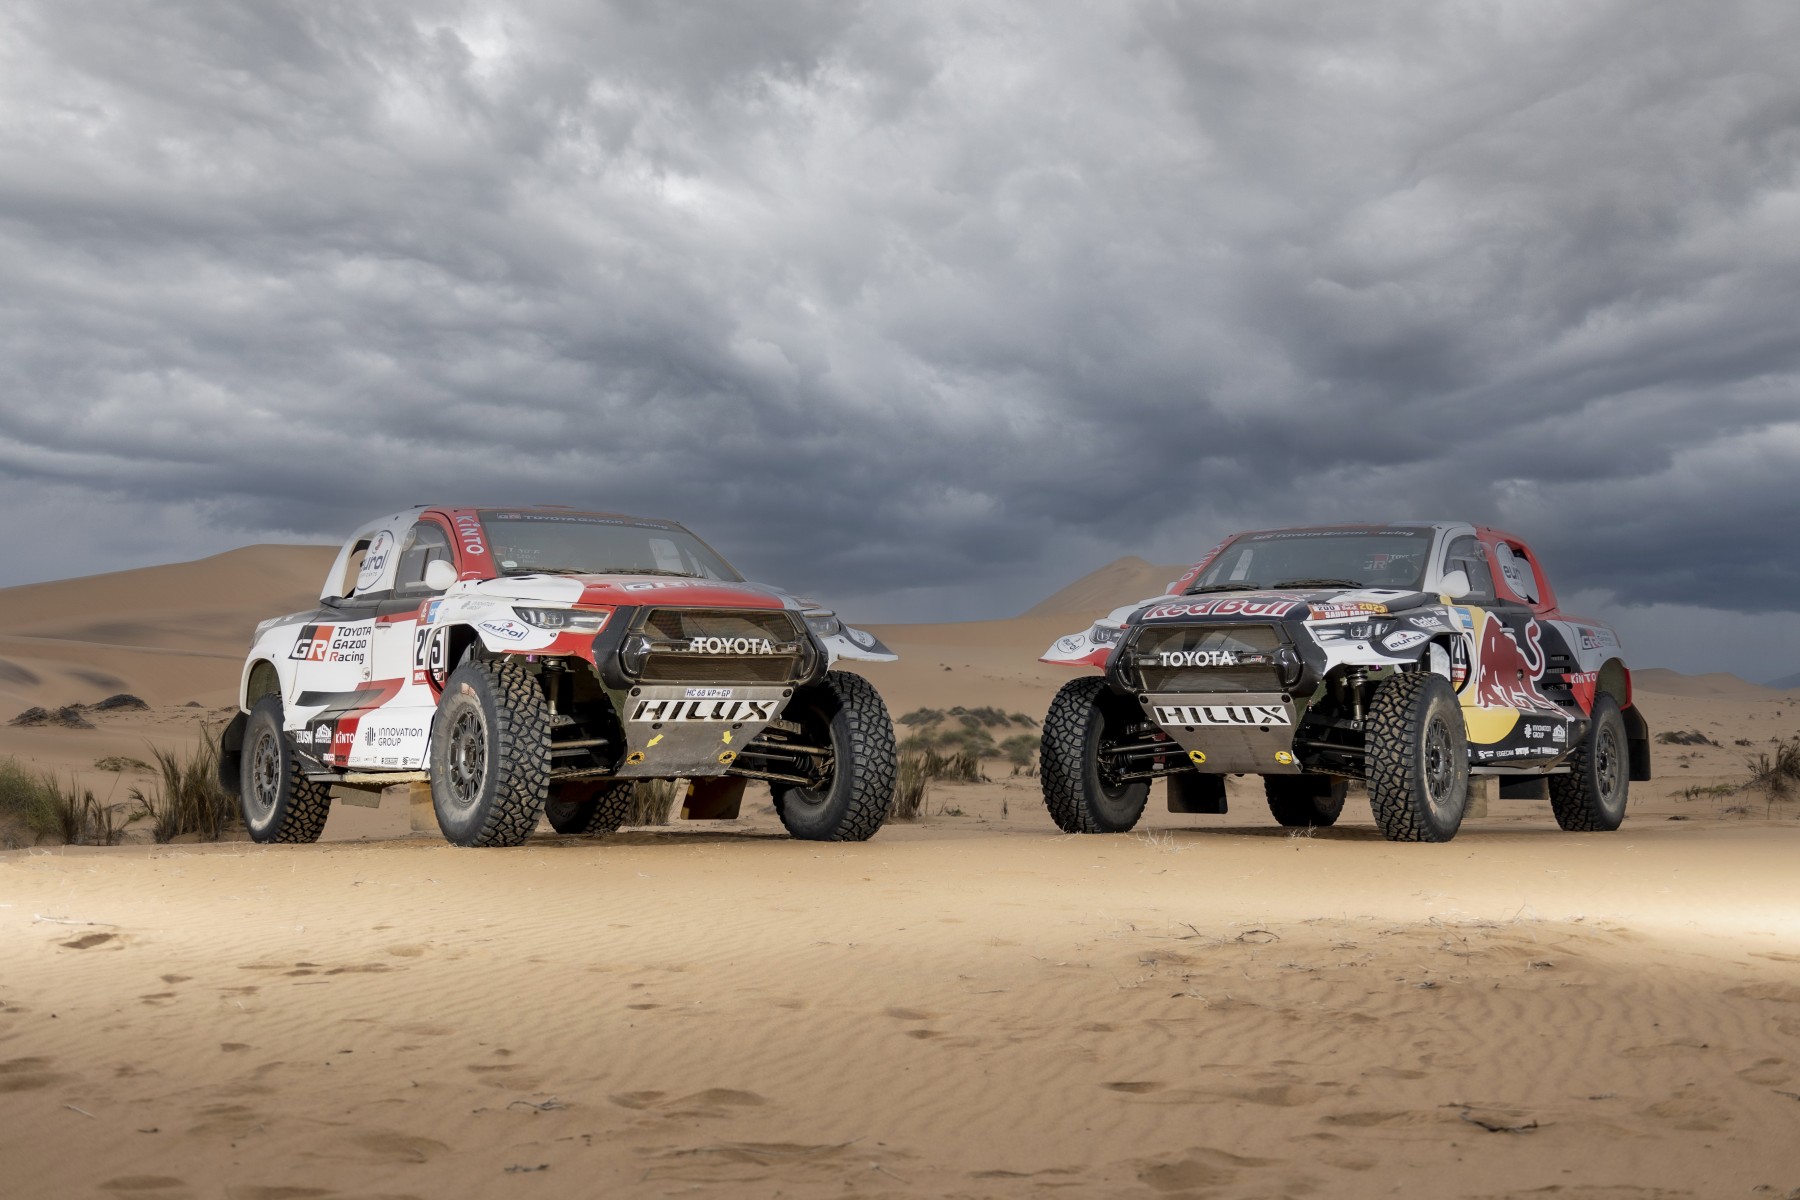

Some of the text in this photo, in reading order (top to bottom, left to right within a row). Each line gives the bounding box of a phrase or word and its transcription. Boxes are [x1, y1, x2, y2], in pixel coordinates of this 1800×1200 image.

[337, 626, 372, 637] TOYOTA
[483, 622, 525, 639] eurol
[695, 637, 773, 654] TOYOTA
[1389, 634, 1425, 649] eurol
[329, 651, 365, 664] Racing
[1160, 650, 1234, 666] TOYOTA
[632, 701, 775, 720] HILUX
[1155, 706, 1288, 724] HILUX
[378, 727, 423, 738] INNOVATION
[378, 737, 402, 747] GROUP
